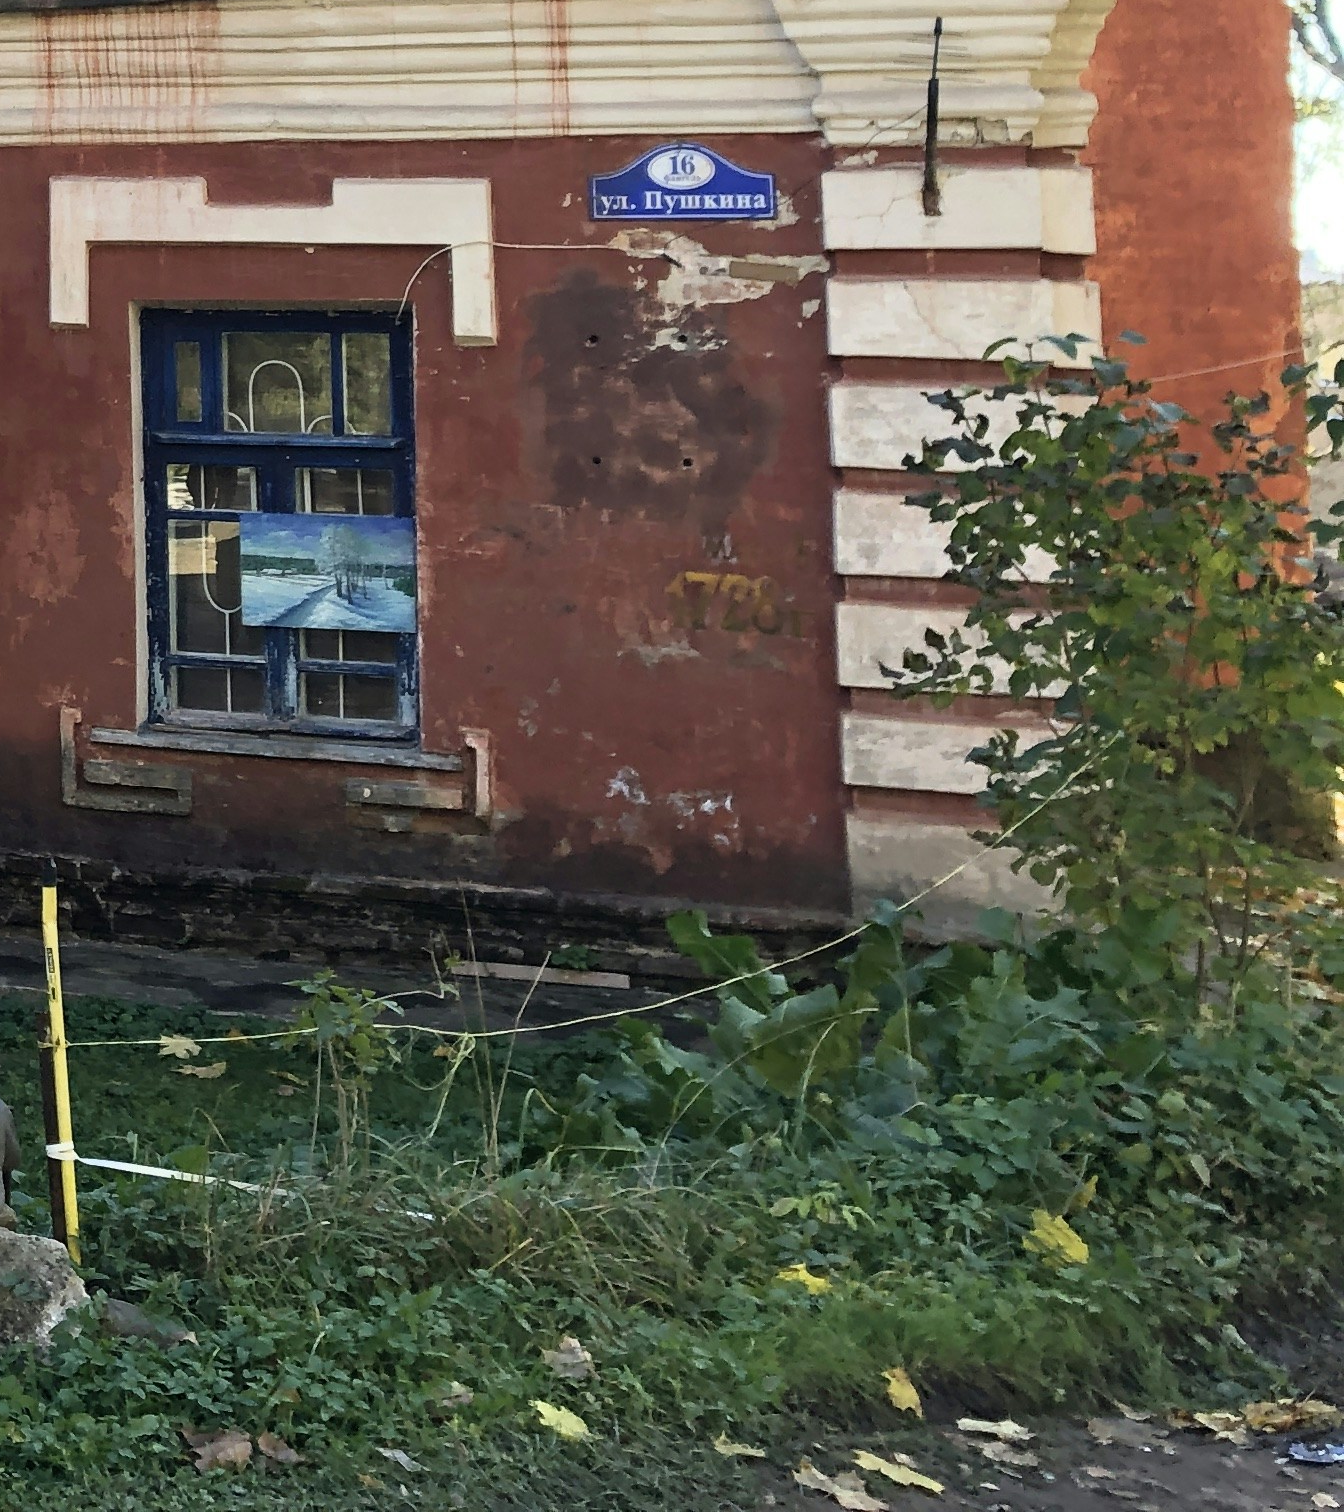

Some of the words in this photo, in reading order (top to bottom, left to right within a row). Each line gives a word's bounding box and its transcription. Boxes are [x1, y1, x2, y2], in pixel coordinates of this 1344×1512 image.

[669, 155, 695, 175] 16
[600, 193, 636, 214] ул.
[644, 191, 766, 214] Пушкина
